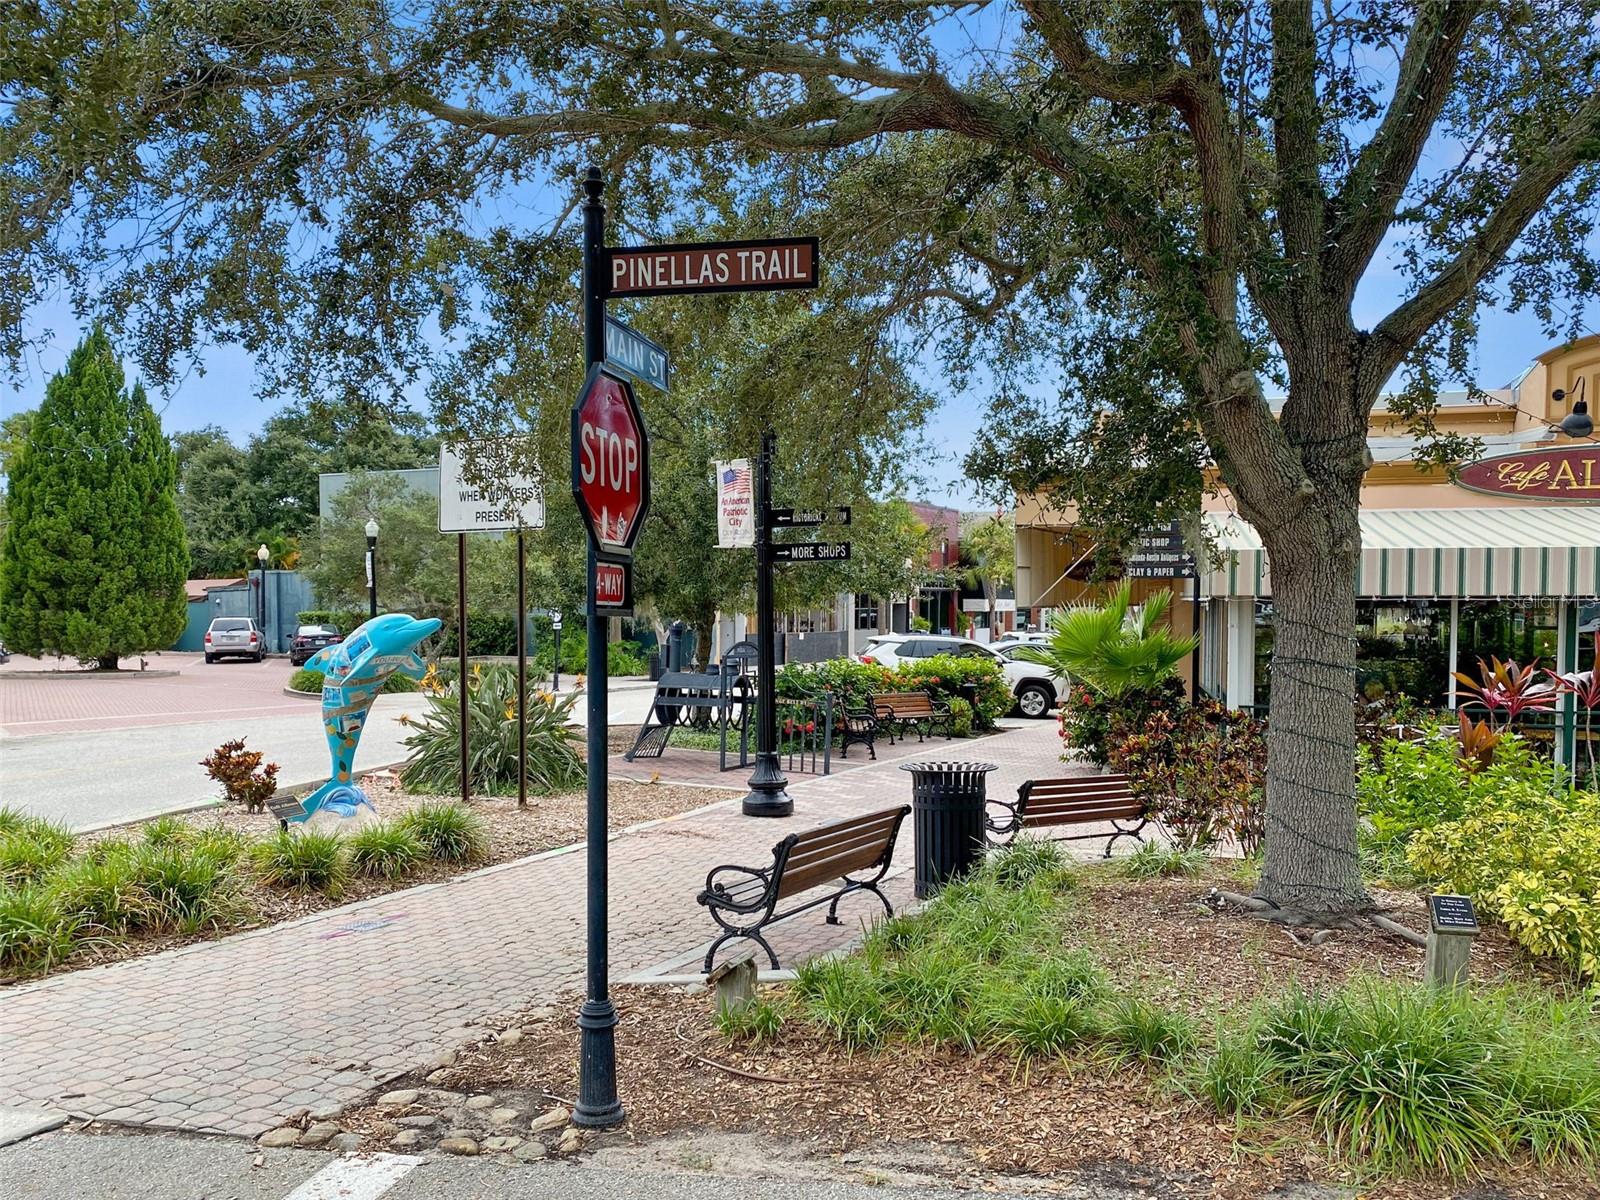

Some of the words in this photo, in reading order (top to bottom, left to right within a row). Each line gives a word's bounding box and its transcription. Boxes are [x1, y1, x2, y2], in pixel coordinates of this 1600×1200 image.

[612, 253, 730, 289] PINELLAS
[736, 248, 807, 282] TRAIL
[606, 328, 644, 371] MAIN
[649, 351, 666, 381] ST
[580, 421, 638, 494] STOP
[722, 507, 749, 517] Patriotic
[728, 518, 743, 528] City
[1151, 538, 1169, 547] SHOP
[791, 546, 815, 559] MORE
[818, 545, 847, 557] SHOPS
[1129, 568, 1145, 577] CLAY
[1153, 568, 1174, 577] PAPER
[596, 572, 622, 596] 4-WAY
